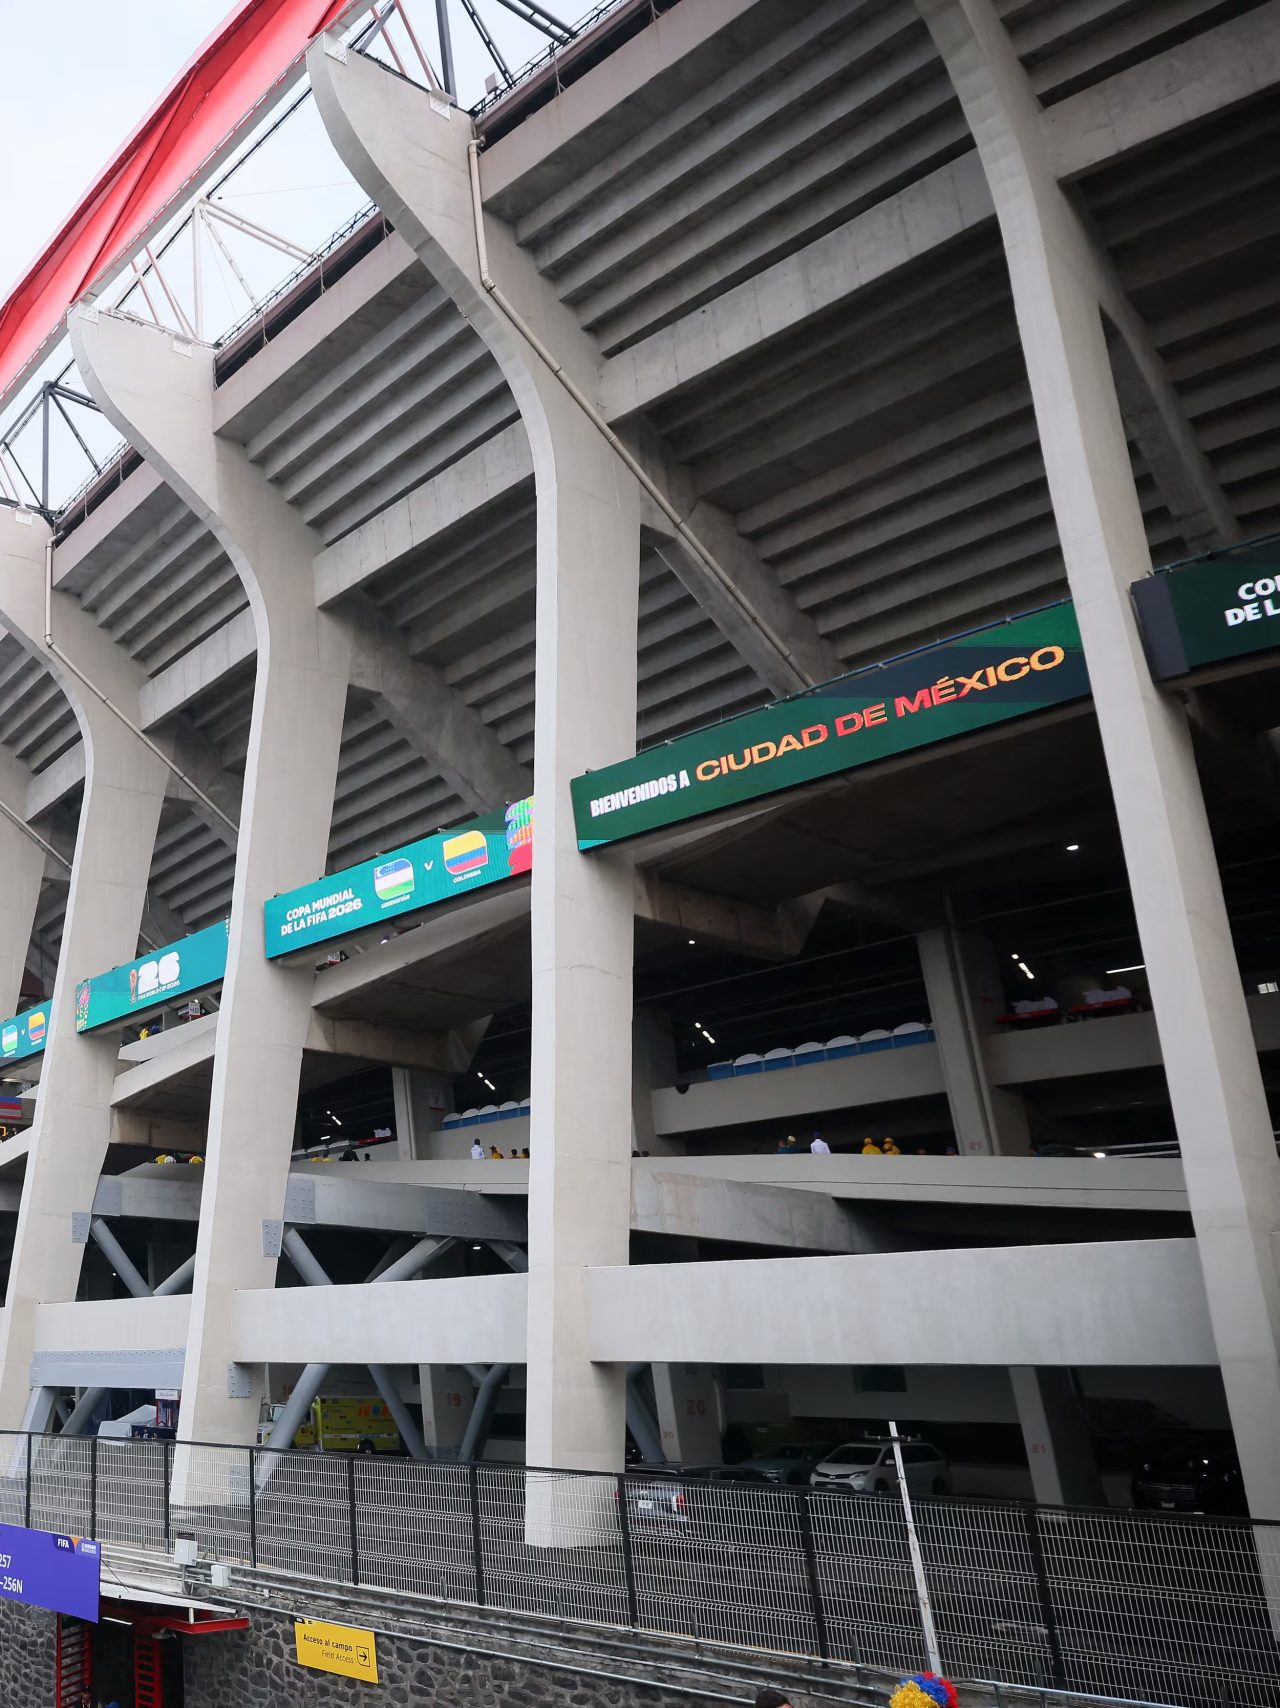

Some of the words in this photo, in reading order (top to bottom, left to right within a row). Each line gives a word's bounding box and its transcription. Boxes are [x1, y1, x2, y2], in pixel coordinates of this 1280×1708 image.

[1224, 602, 1262, 627] DE
[590, 773, 677, 817] BIENVENIDOS
[678, 769, 690, 789] A
[695, 723, 829, 781] CIUDAD
[834, 703, 888, 737] DE
[894, 645, 1065, 718] MÉXICO
[280, 922, 293, 937] DE
[294, 918, 306, 931] LA
[307, 911, 328, 927] FIFA
[328, 898, 363, 919] 2026
[286, 904, 311, 922] COPA
[312, 888, 355, 912] MUNDIAL
[137, 951, 181, 995] 26
[687, 1399, 705, 1416] 20
[57, 1538, 70, 1549] FIFA
[303, 1634, 323, 1645] Acceso
[324, 1639, 330, 1647] al
[331, 1641, 353, 1652] campo
[321, 1649, 335, 1659] Field
[336, 1654, 354, 1663] Access
